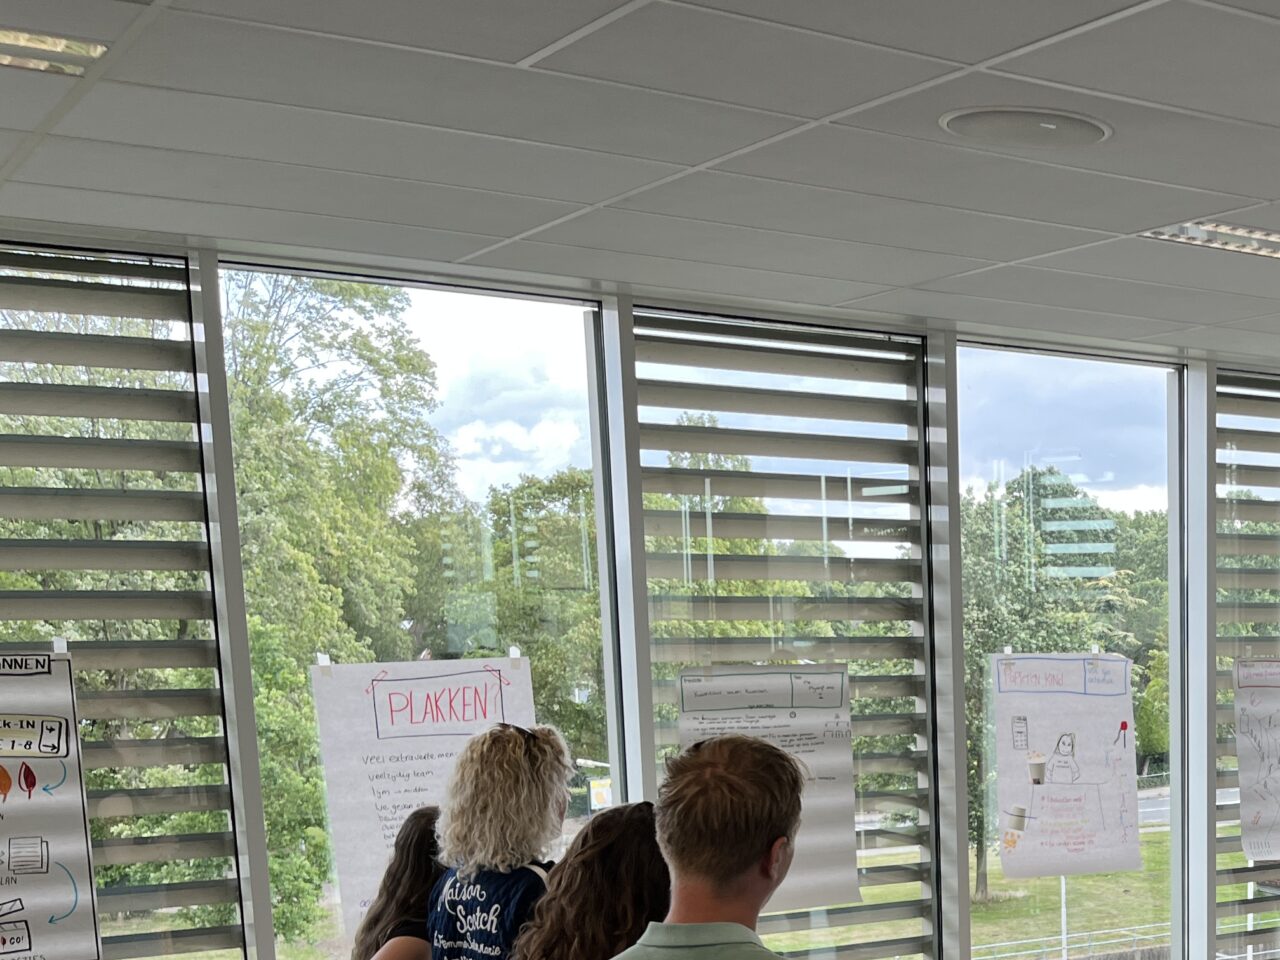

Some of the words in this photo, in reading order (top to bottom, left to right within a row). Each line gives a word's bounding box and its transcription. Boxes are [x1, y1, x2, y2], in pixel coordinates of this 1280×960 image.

[388, 682, 501, 726] PLAKKEN?
[438, 875, 486, 912] Maison
[456, 903, 501, 934] Scotch
